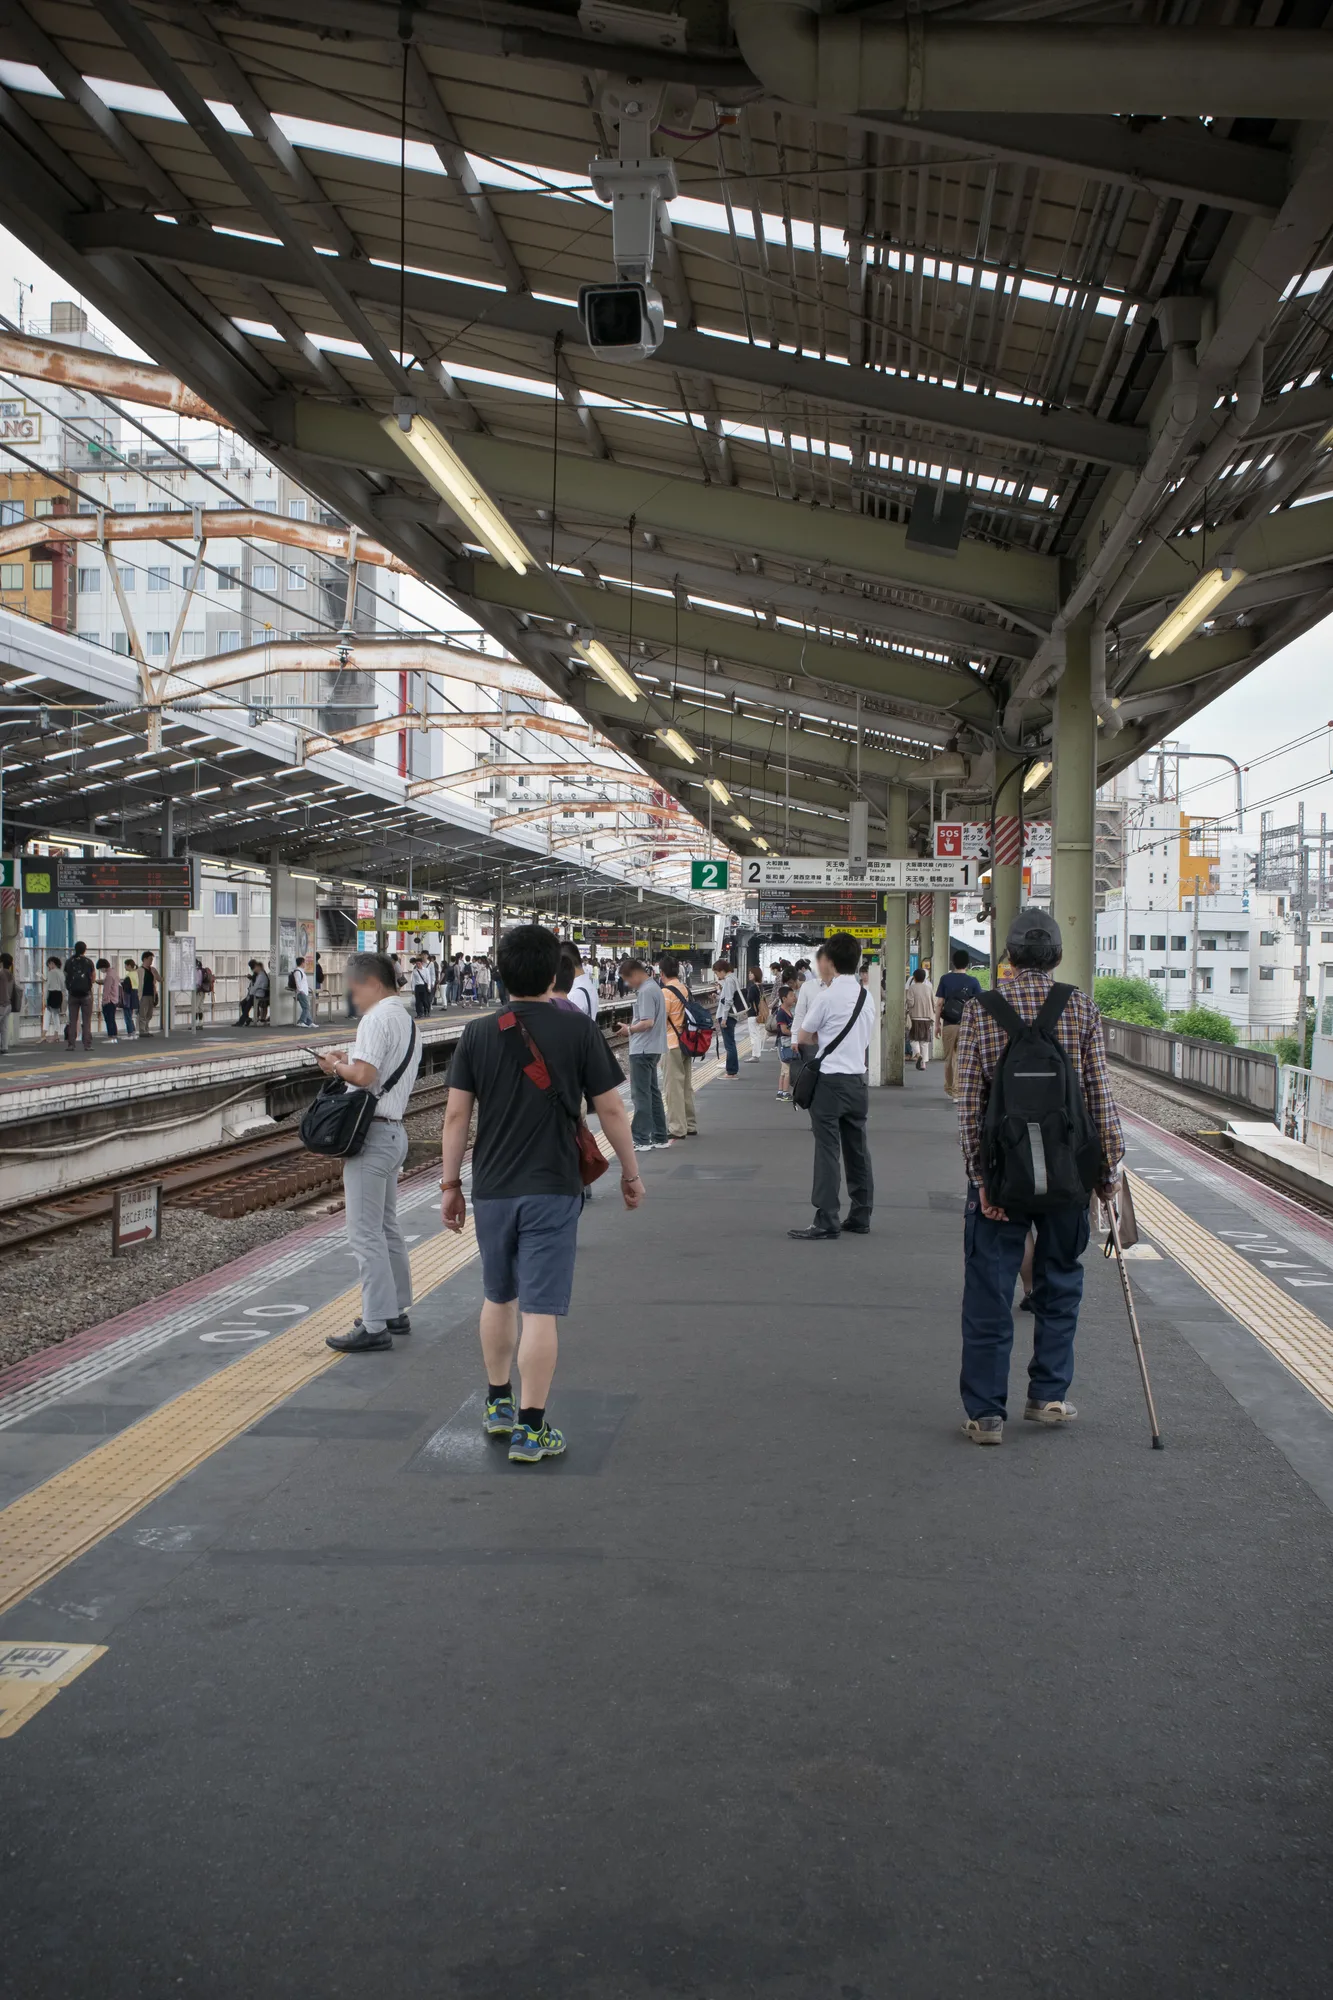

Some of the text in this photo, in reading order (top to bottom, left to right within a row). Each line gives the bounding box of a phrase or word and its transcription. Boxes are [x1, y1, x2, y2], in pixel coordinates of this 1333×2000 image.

[702, 864, 718, 887] 2
[748, 862, 761, 883] 2
[961, 864, 969, 885] 1
